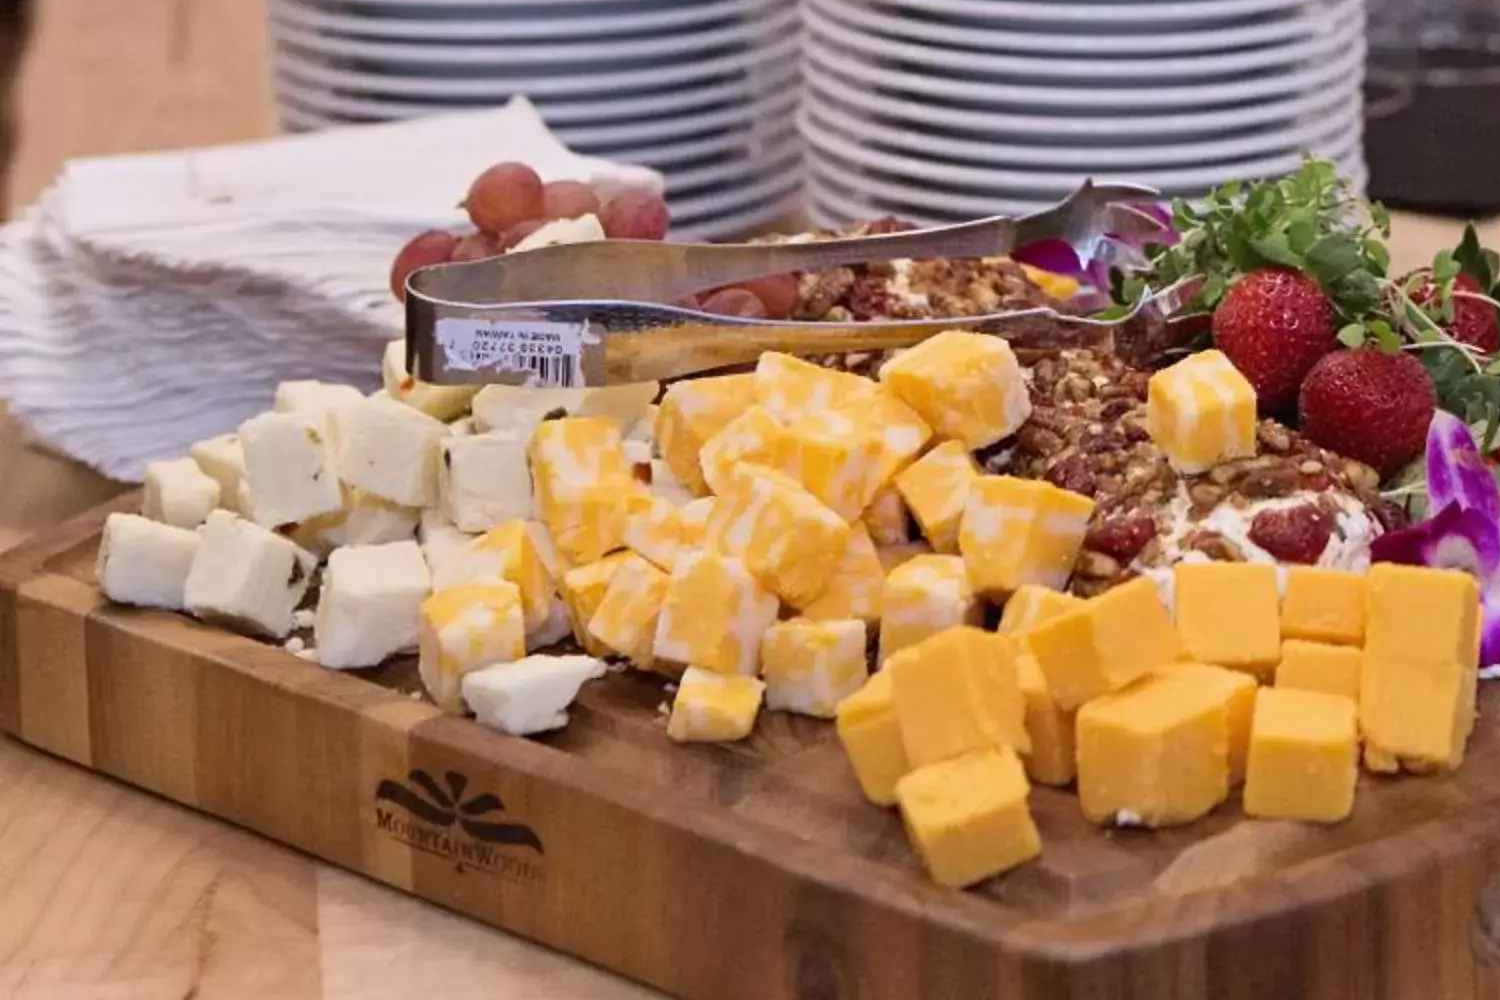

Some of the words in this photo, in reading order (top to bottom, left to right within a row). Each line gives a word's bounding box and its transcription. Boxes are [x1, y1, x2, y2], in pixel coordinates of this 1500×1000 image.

[475, 328, 515, 340] TAIWAN
[517, 330, 529, 340] IN
[530, 331, 561, 342] MADE
